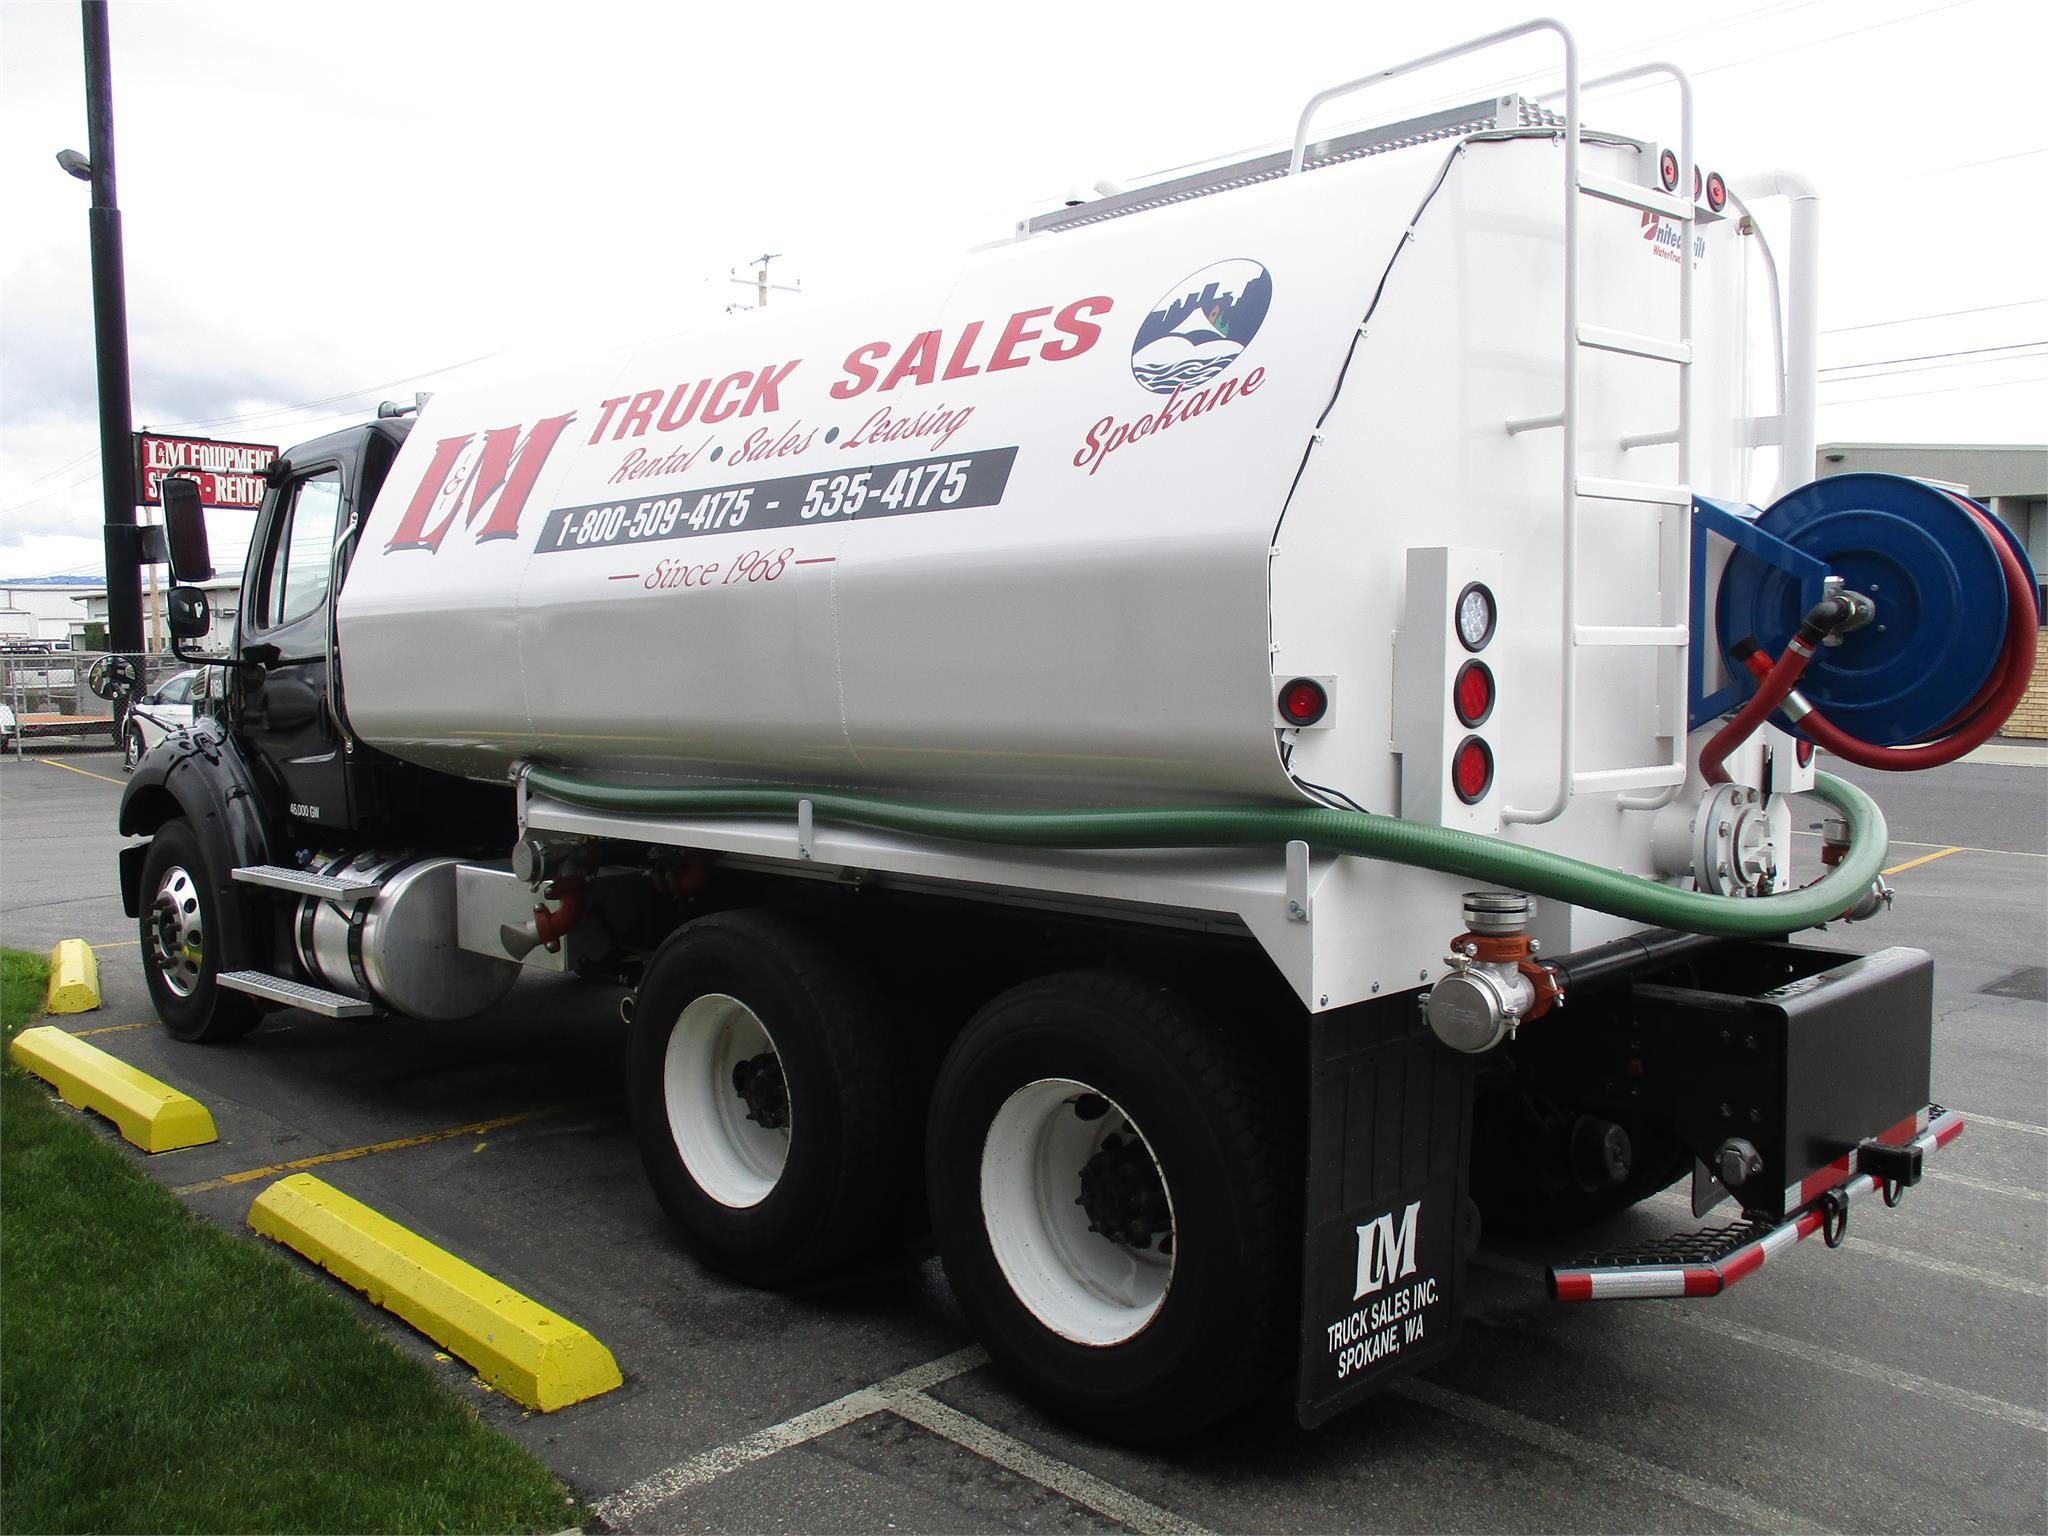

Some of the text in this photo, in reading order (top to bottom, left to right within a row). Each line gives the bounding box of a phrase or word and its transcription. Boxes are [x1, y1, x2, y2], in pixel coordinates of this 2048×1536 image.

[588, 295, 1114, 446] TRUCK SALES
[607, 402, 976, 485] Rental Sales Leasing
[1073, 366, 1266, 476] Spokane
[215, 475, 267, 503] RENTA
[556, 488, 756, 547] 1-800-509-4175
[800, 460, 972, 519] 535-4175
[643, 547, 795, 590] Since 1968
[1327, 1278, 1439, 1353] TRUCK SALES INC.
[1338, 1314, 1424, 1379] SPOKANE, WA
